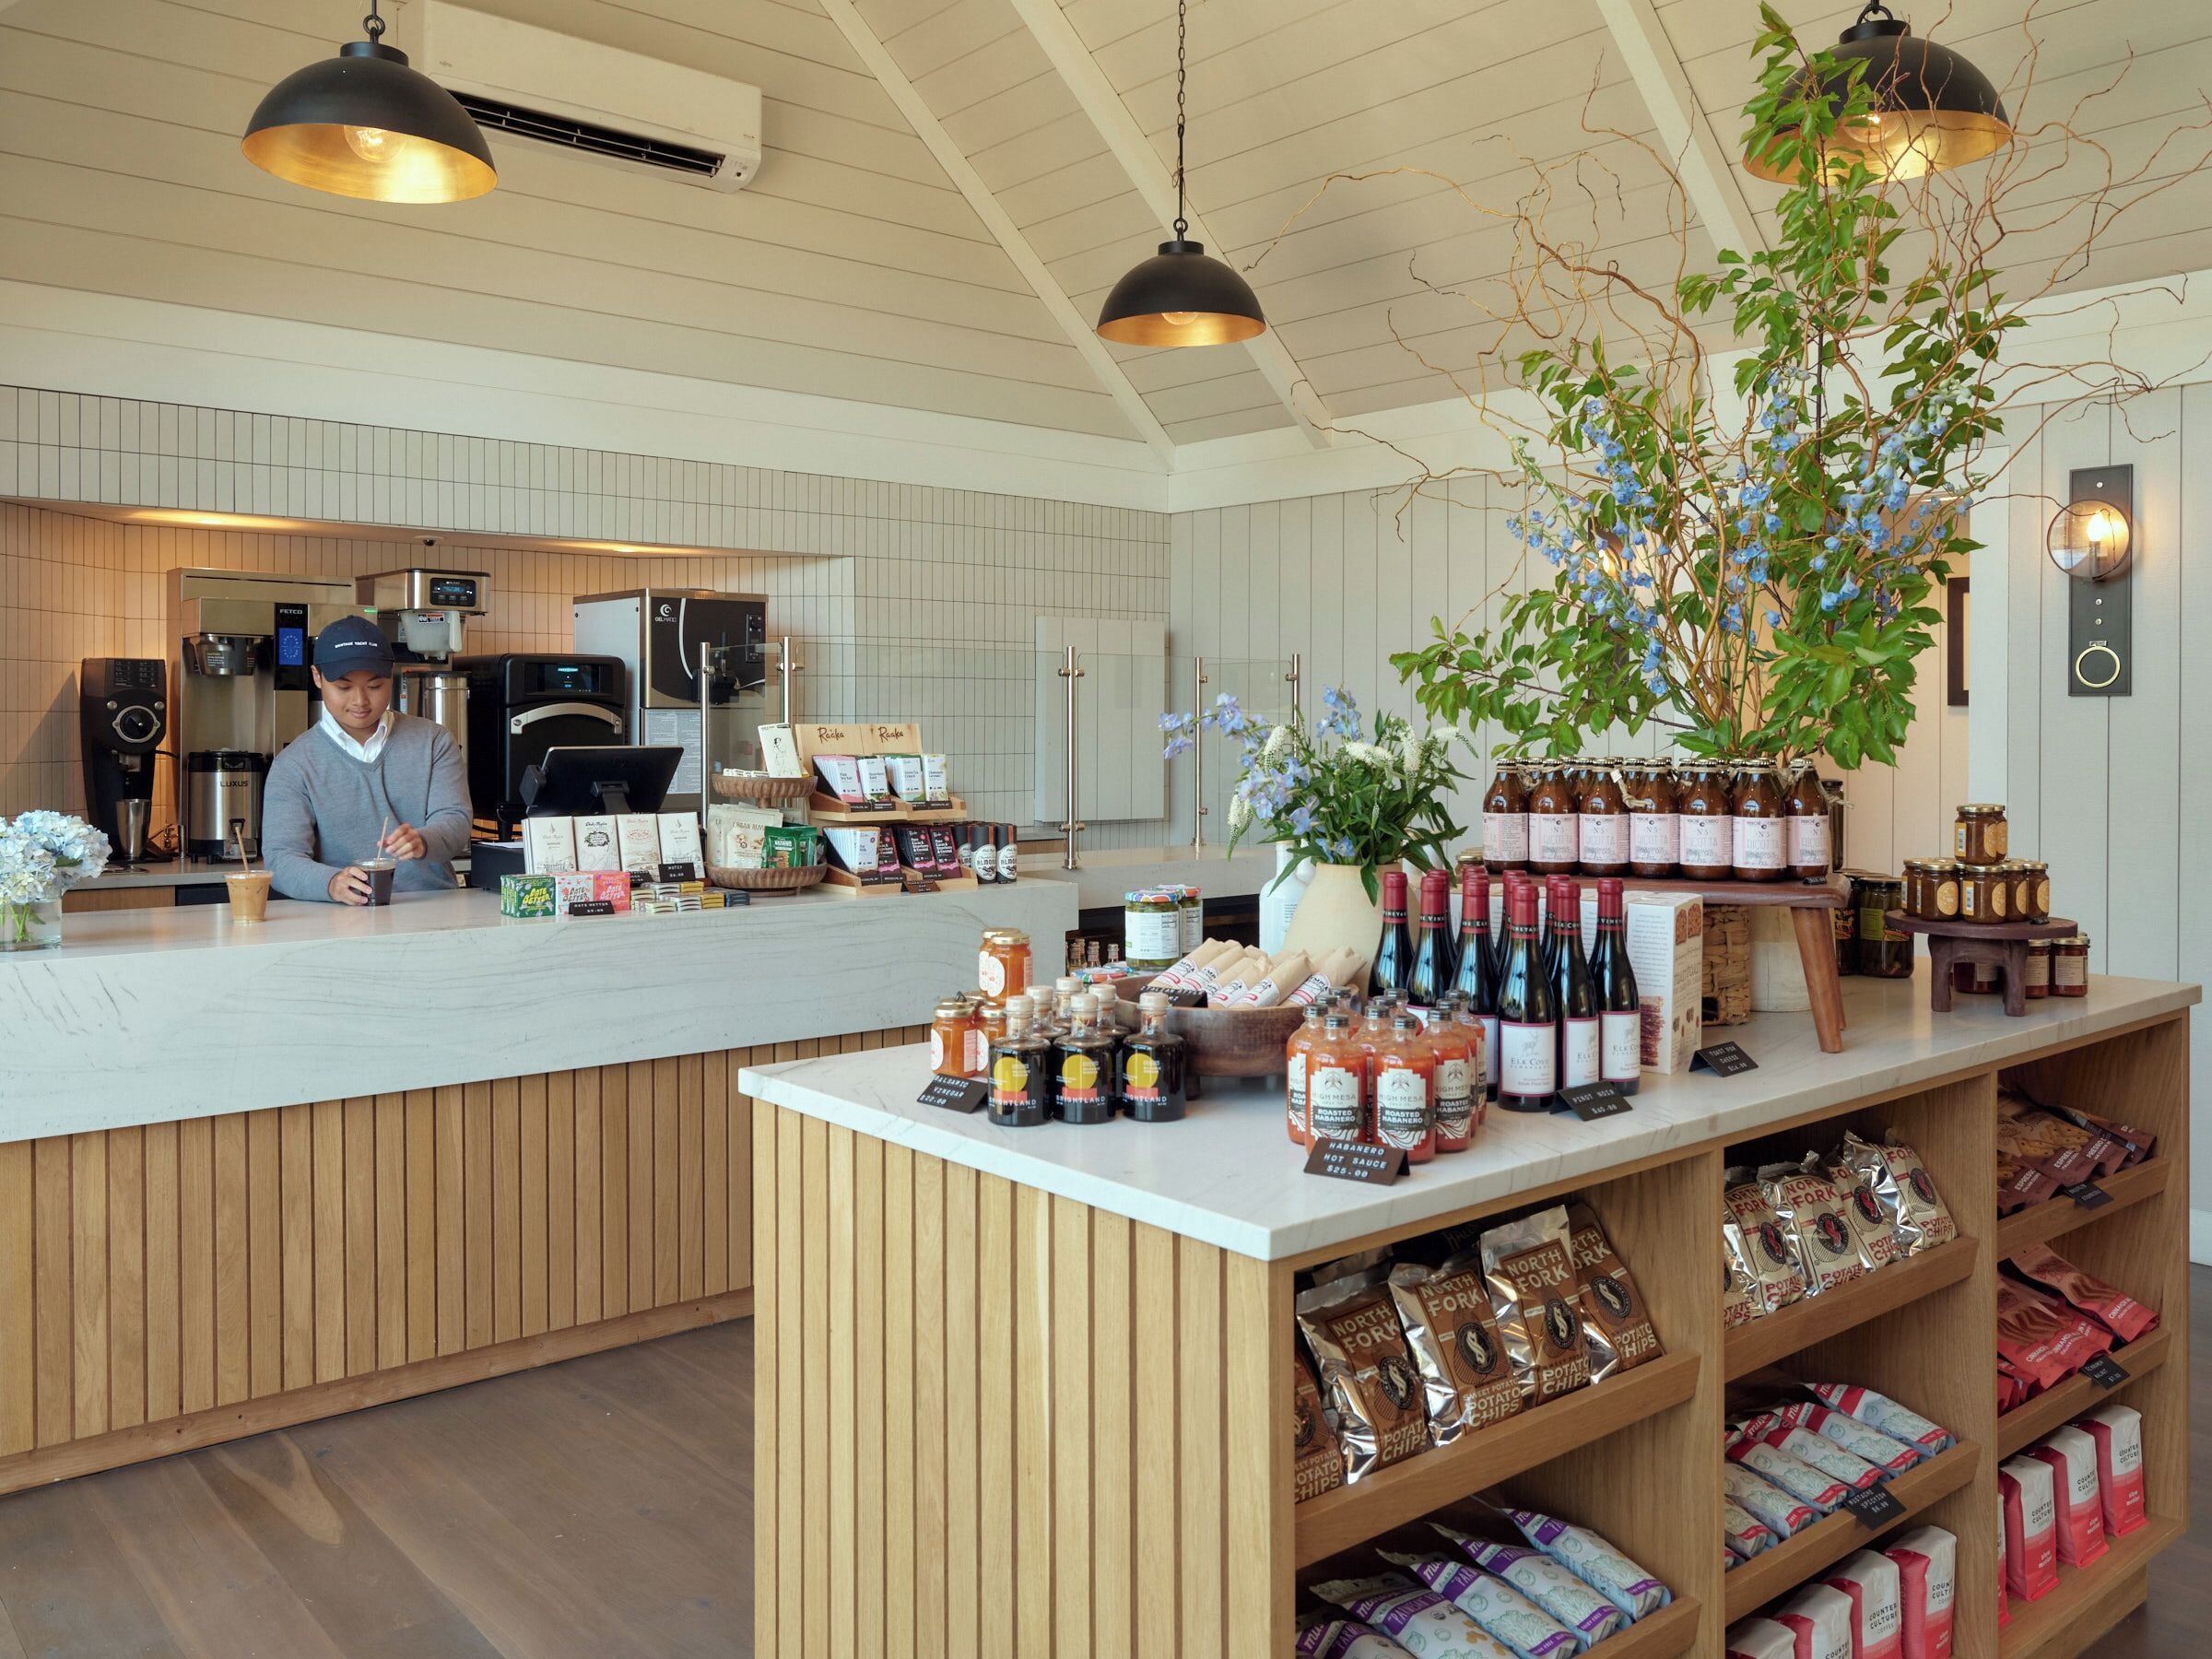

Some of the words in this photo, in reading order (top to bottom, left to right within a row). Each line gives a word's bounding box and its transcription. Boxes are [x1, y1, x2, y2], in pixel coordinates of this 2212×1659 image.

[878, 726, 903, 743] Raaka
[523, 894, 550, 904] BETTER
[934, 1076, 969, 1088] BALSAMIC
[934, 1087, 965, 1098] VINEGAR
[1572, 1093, 1592, 1104] PINOT
[1315, 1114, 1355, 1123] HABANERO
[1383, 1116, 1423, 1124] HABANERO
[1329, 1142, 1384, 1155] HABANERO
[1324, 1153, 1344, 1162] HOT
[1352, 1157, 1387, 1169] SAUCE
[1327, 1164, 1369, 1178] $25.00
[1791, 1186, 1838, 1208] FORK
[1735, 1197, 1770, 1217] FORK
[1926, 1225, 1952, 1238] CHIPS
[1571, 1230, 1600, 1253] RTH
[1508, 1249, 1562, 1277] NORTH
[1573, 1241, 1612, 1270] ORK
[1515, 1264, 1570, 1292] FORK
[1820, 1262, 1862, 1281] POTATO
[1420, 1275, 1475, 1299] NORTH
[1428, 1288, 1483, 1318] FORK
[1333, 1305, 1392, 1336] NORTH
[1724, 1311, 1751, 1329] HIPS
[1342, 1319, 1401, 1354] FORK
[1469, 1387, 1520, 1411] POTATO
[1469, 1399, 1520, 1428] CHIPS
[1384, 1421, 1424, 1447] POTAT
[1295, 1460, 1339, 1485] OTATO
[1869, 1603, 1897, 1621] COUNTER
[1870, 1611, 1898, 1630] CULTURE
